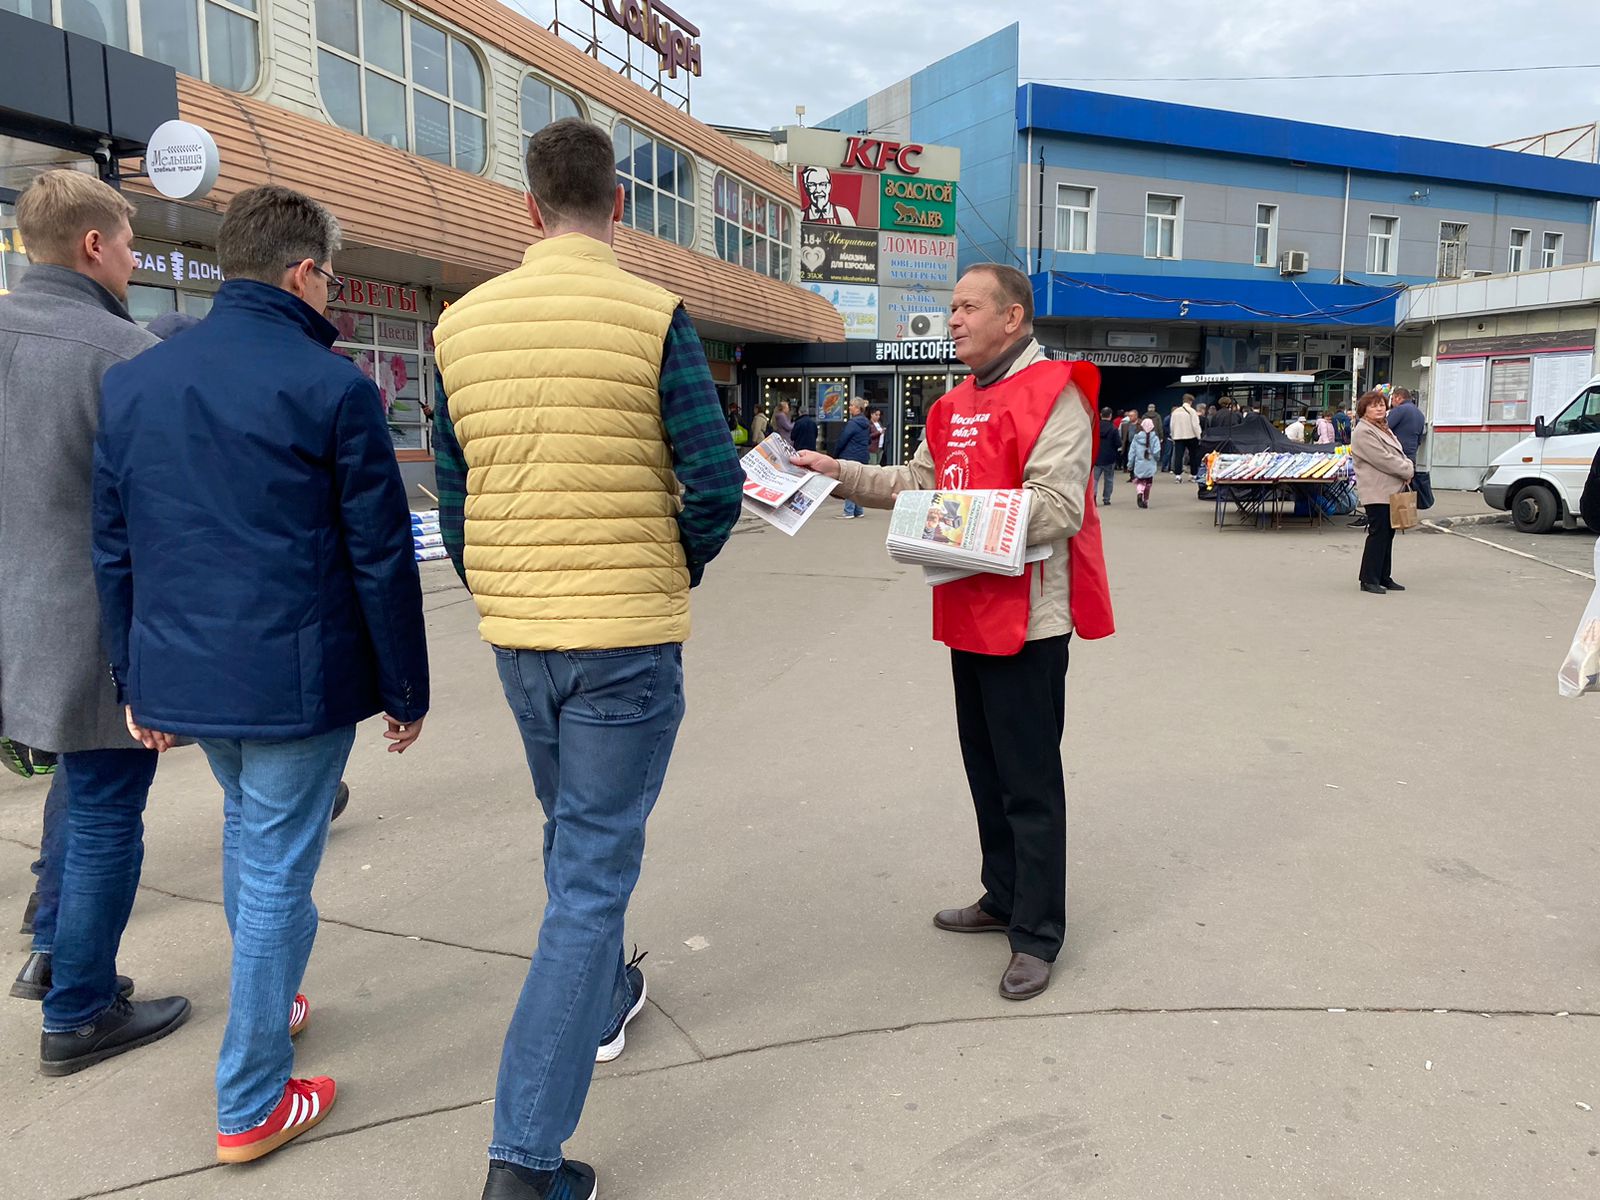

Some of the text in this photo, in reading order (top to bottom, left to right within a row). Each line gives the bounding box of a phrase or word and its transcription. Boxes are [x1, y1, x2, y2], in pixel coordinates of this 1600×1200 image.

[151, 149, 203, 167] Мельница
[841, 136, 924, 174] KFC
[885, 179, 953, 203] ЗОЛОТОЙ
[803, 233, 822, 245] 18+
[882, 236, 956, 259] ЛОМБАРД
[830, 260, 844, 269] ДЛЯ
[839, 252, 867, 262] МАГАЗИН
[188, 260, 225, 281] ДОН
[806, 272, 824, 280] ЭТАЖ
[378, 321, 417, 341] Цветы
[896, 324, 904, 338] 2
[875, 342, 884, 360] ONE
[883, 342, 919, 360] PRICE
